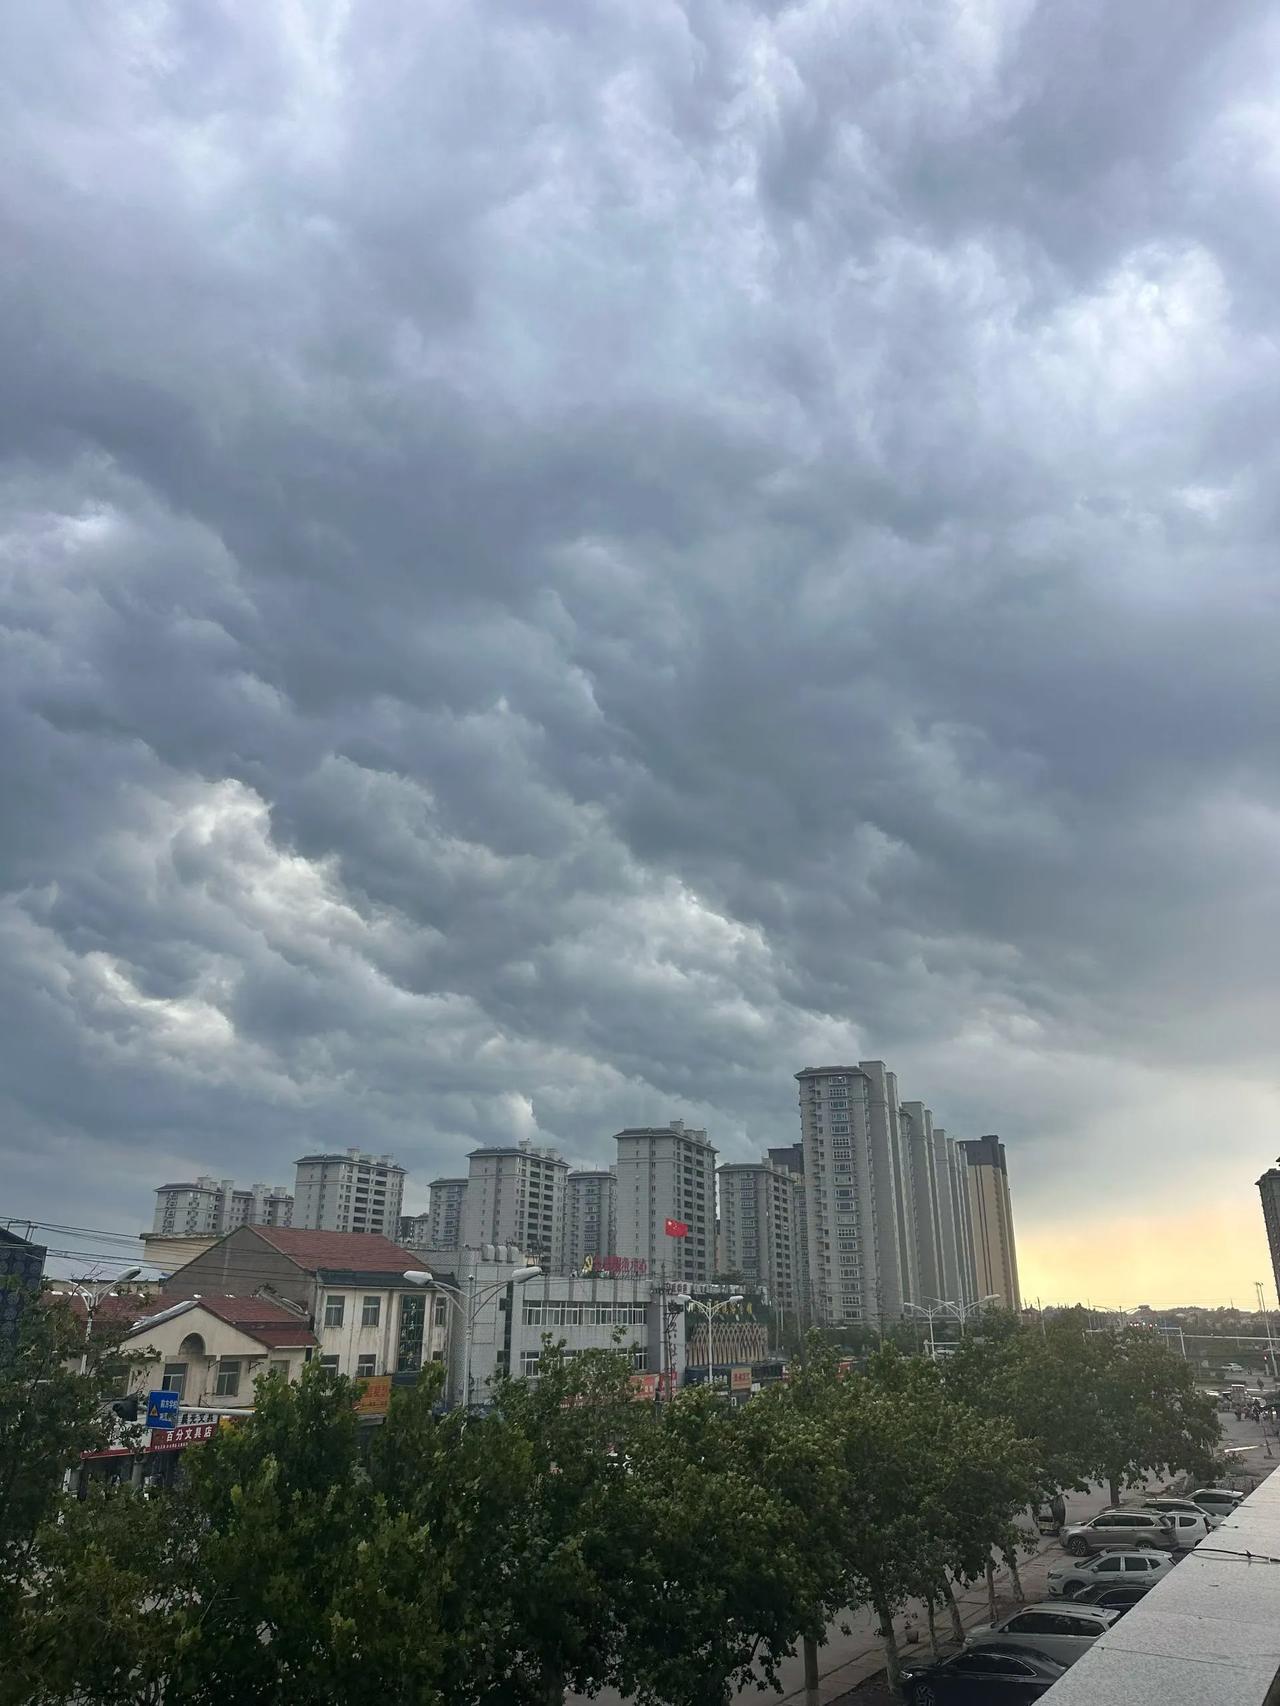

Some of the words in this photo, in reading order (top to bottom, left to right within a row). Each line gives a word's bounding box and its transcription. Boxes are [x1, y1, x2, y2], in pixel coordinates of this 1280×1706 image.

[166, 1426, 213, 1442] 百分文具店
